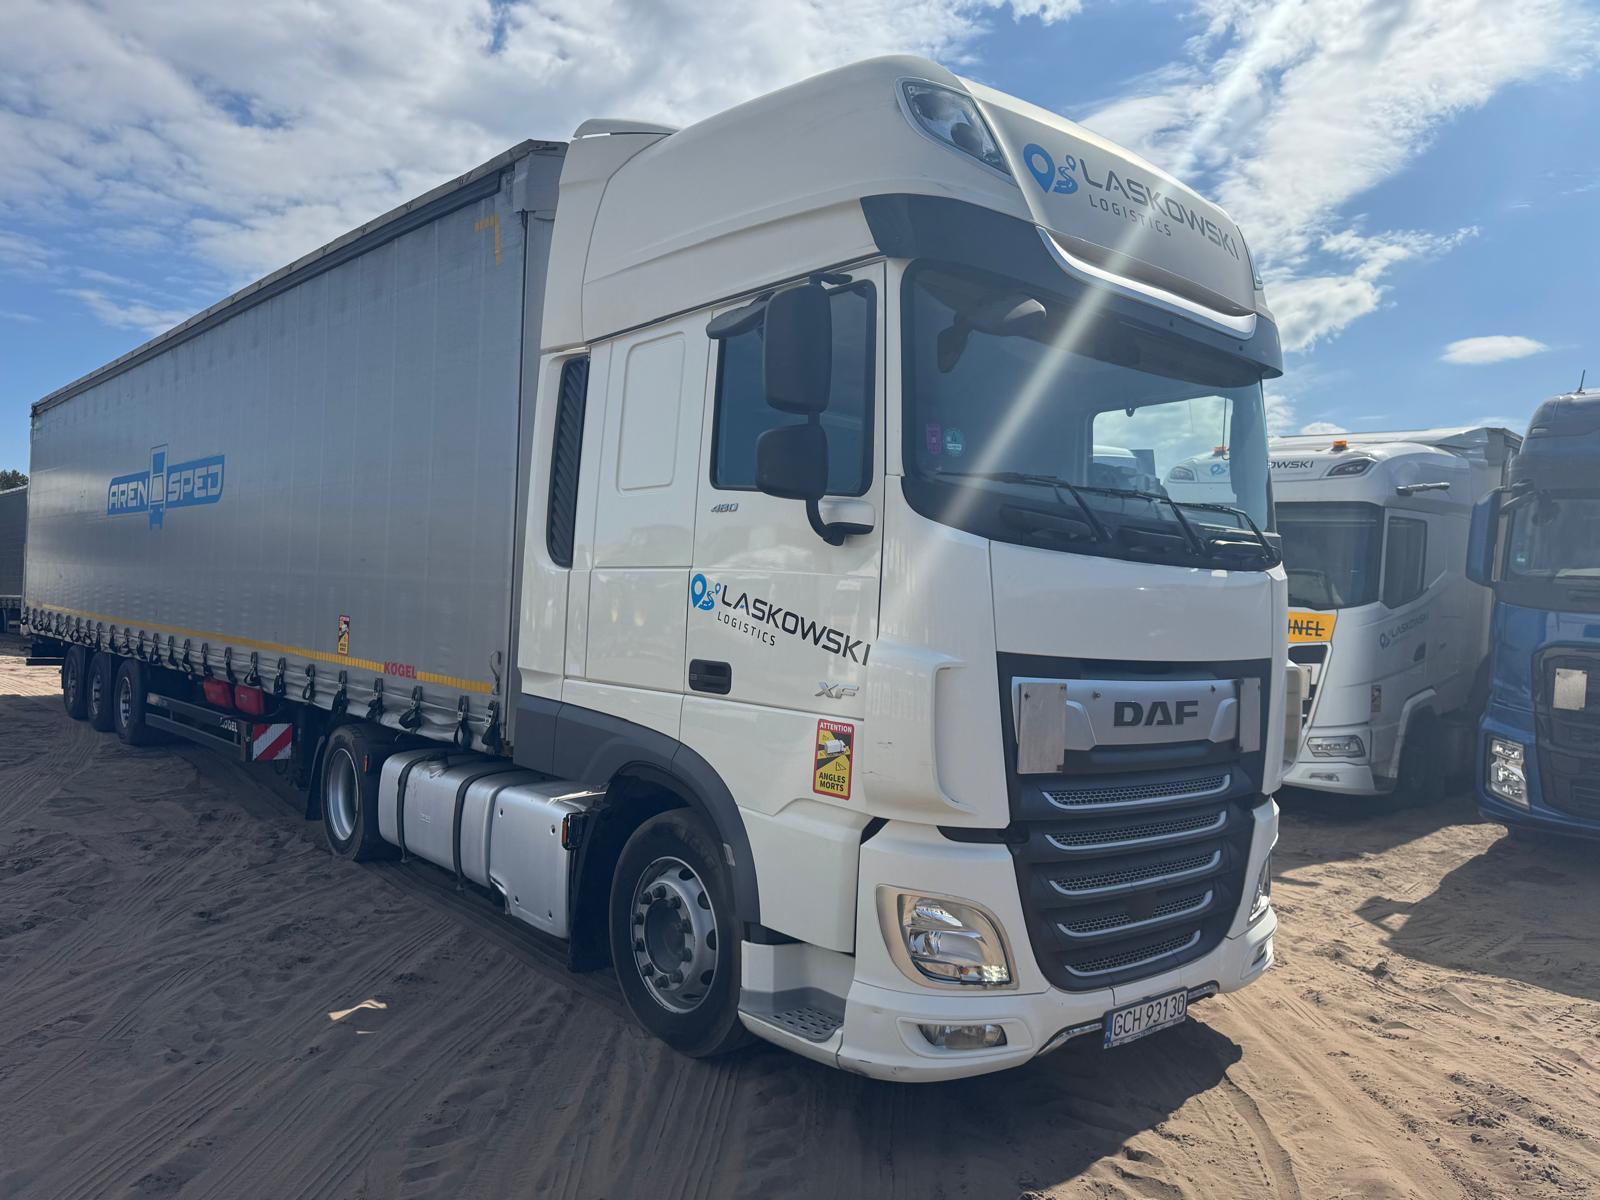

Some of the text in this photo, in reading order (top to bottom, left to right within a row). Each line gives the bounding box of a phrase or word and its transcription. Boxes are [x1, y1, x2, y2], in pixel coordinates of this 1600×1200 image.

[1080, 158, 1239, 260] LASKOWSKI
[1089, 194, 1171, 237] LOGISTICS
[717, 611, 776, 646] LOGISTICS
[721, 585, 871, 666] LASKOWSKI
[1288, 618, 1326, 637] NEL
[814, 681, 860, 699] XF
[819, 721, 853, 733] ATTENTION
[1113, 700, 1199, 727] DAF
[819, 771, 846, 784] ANGLES
[819, 780, 844, 792] MORTS
[1113, 1007, 1143, 1037] GCH
[1145, 993, 1185, 1028] 93130
